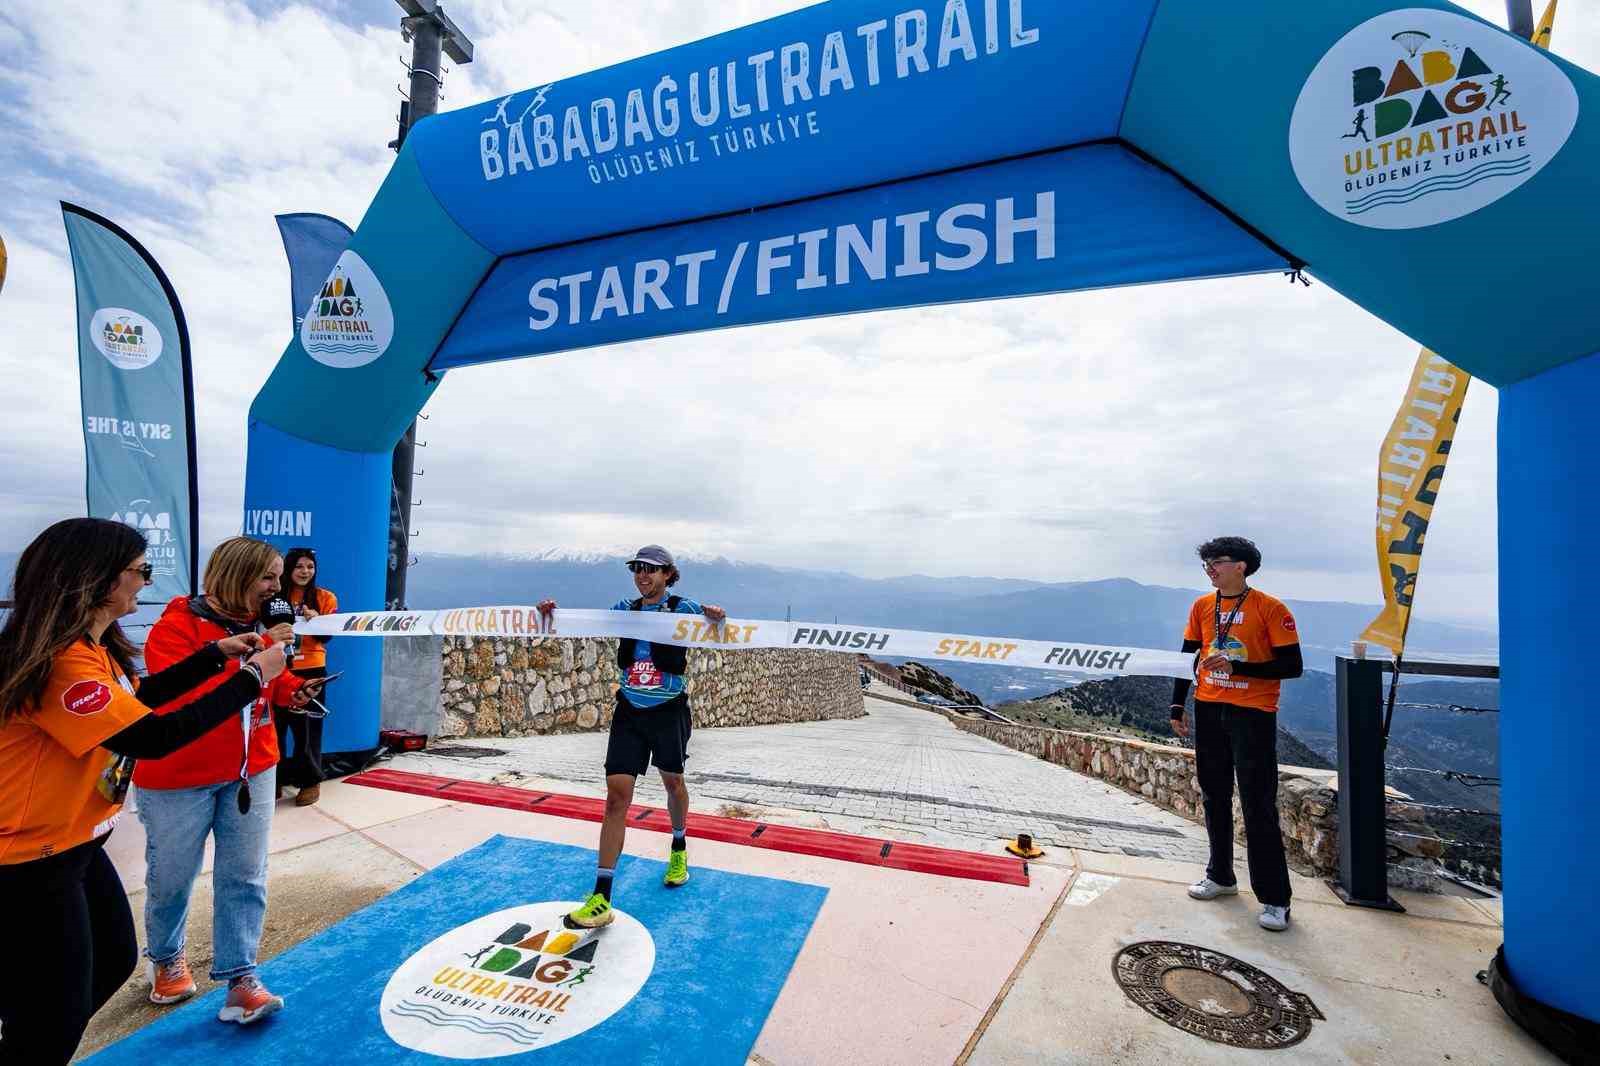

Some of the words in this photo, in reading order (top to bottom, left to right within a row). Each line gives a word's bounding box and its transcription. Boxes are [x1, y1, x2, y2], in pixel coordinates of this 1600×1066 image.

[689, 0, 1040, 127] ULTRATRAIL
[1352, 47, 1494, 108] BABA
[587, 137, 700, 185] ÖLÜDENİZ
[709, 111, 821, 158] TÜRKİYE
[1343, 110, 1528, 176] ULTRATRAIL
[246, 509, 312, 537] LYCIAN
[671, 619, 758, 646] START
[792, 627, 890, 651] FINISH
[934, 638, 1018, 661] START
[1044, 647, 1131, 670] FINISH
[432, 966, 573, 1013] ULTRATRAIL
